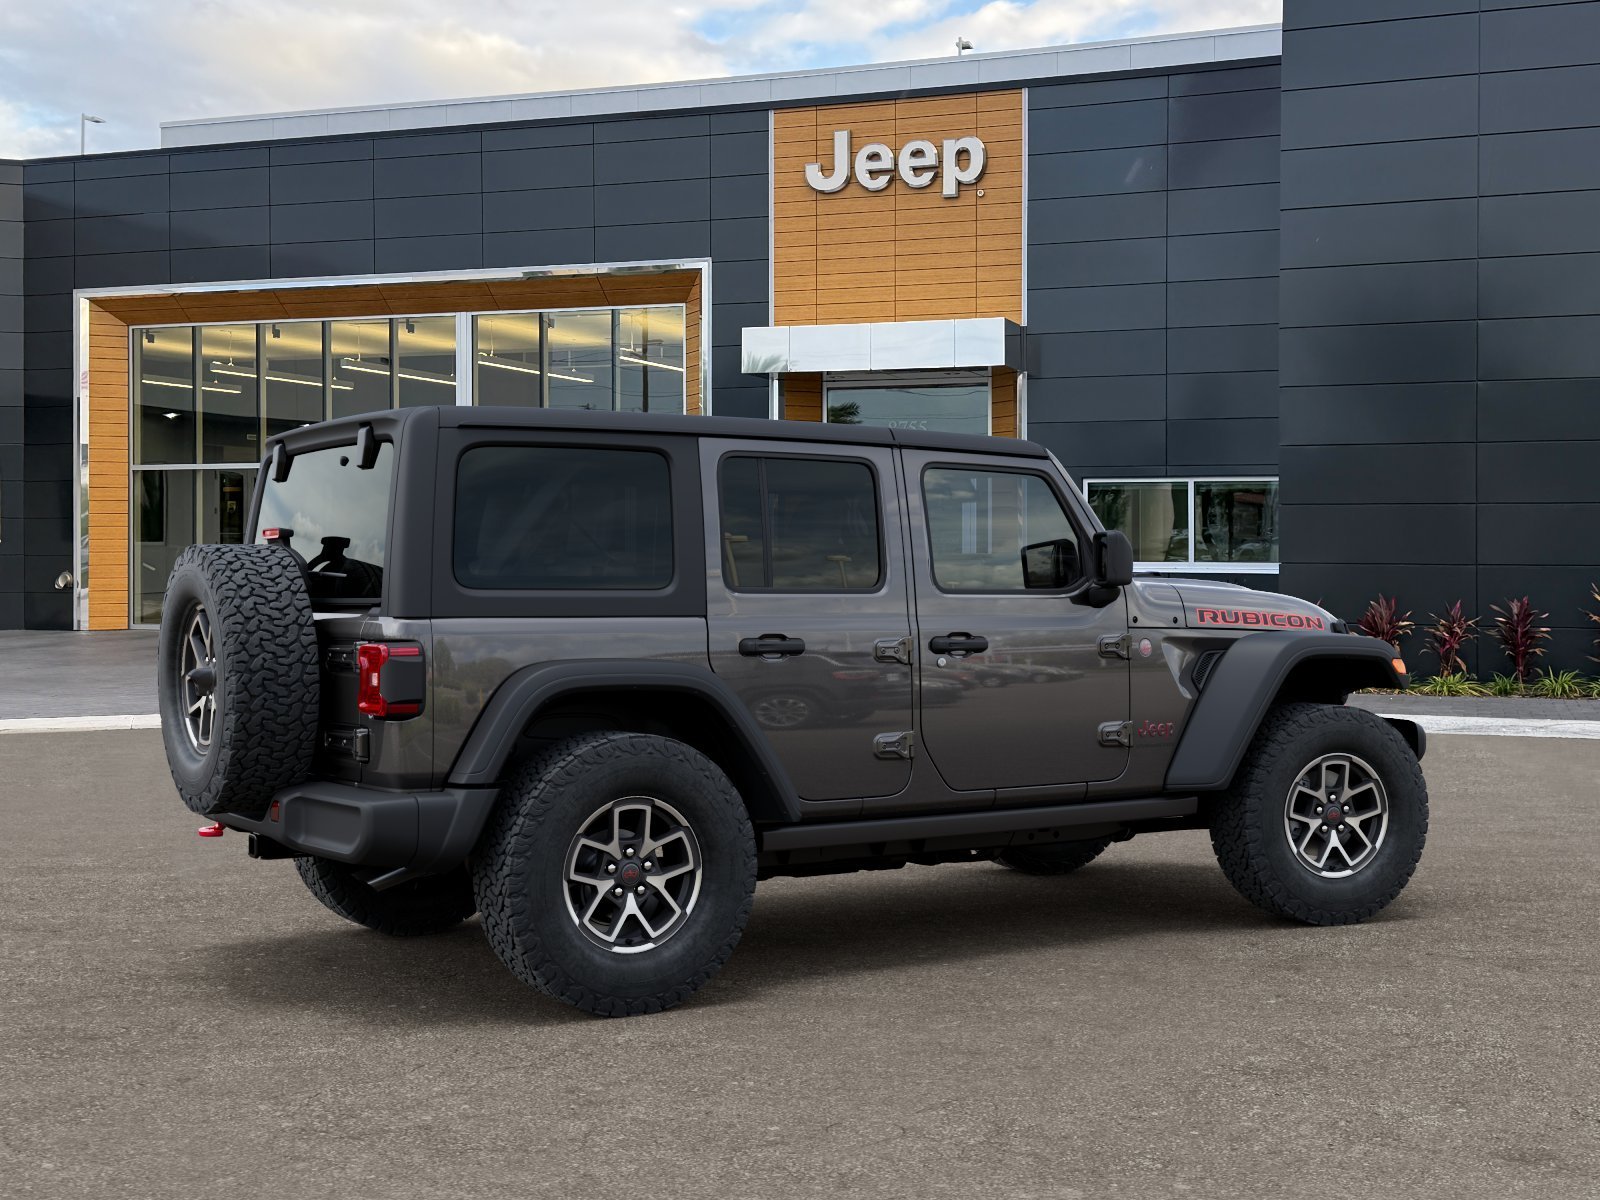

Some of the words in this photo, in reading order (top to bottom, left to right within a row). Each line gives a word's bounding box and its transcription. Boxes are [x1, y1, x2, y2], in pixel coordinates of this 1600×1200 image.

[805, 129, 987, 198] Jeep
[1196, 608, 1325, 631] RUBICON
[1137, 719, 1175, 741] Jeep
